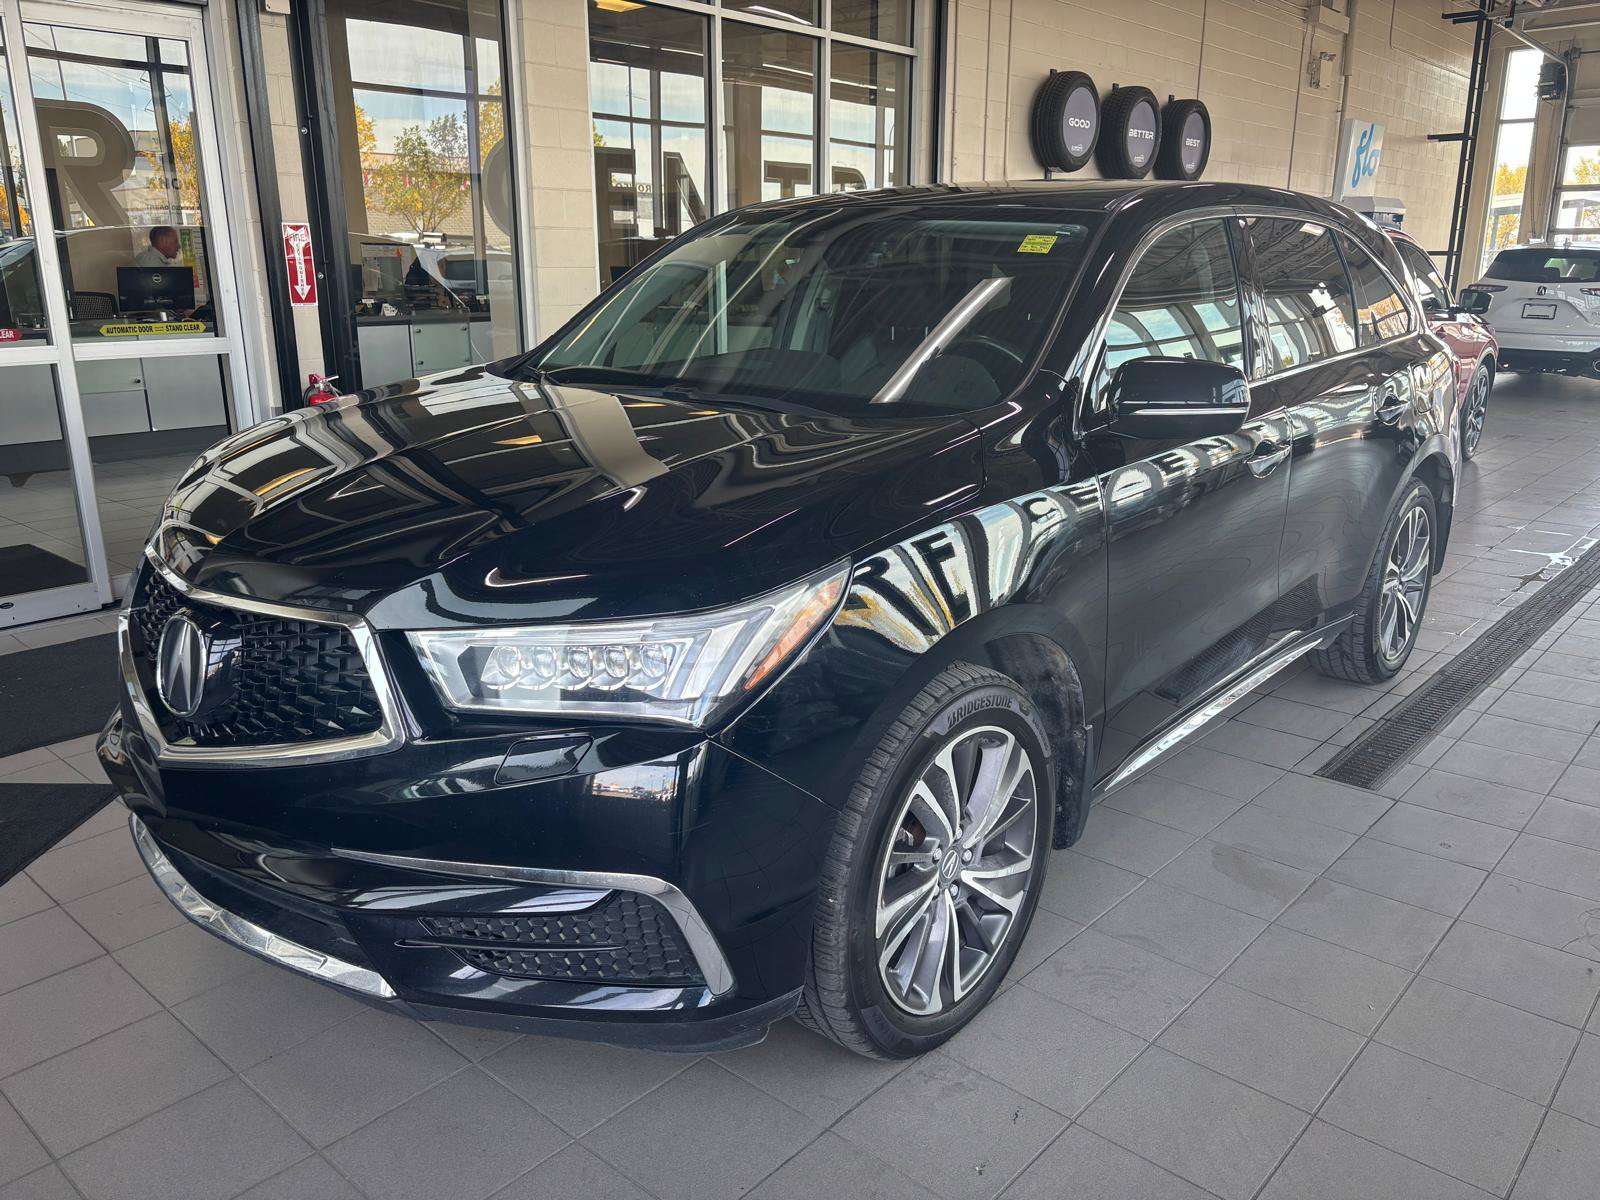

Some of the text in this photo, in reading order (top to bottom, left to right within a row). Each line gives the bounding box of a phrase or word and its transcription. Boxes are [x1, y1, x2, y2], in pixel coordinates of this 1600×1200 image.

[1068, 117, 1091, 129] GOOD
[1128, 128, 1154, 141] BETTER
[1185, 138, 1200, 148] BEST
[1351, 123, 1381, 189] flo
[106, 325, 138, 334] AUTOMATIC
[138, 325, 154, 333] DOOR
[165, 324, 183, 332] STAND
[183, 323, 201, 332] CLEAR
[947, 695, 1013, 729] BRIDGESTONE
